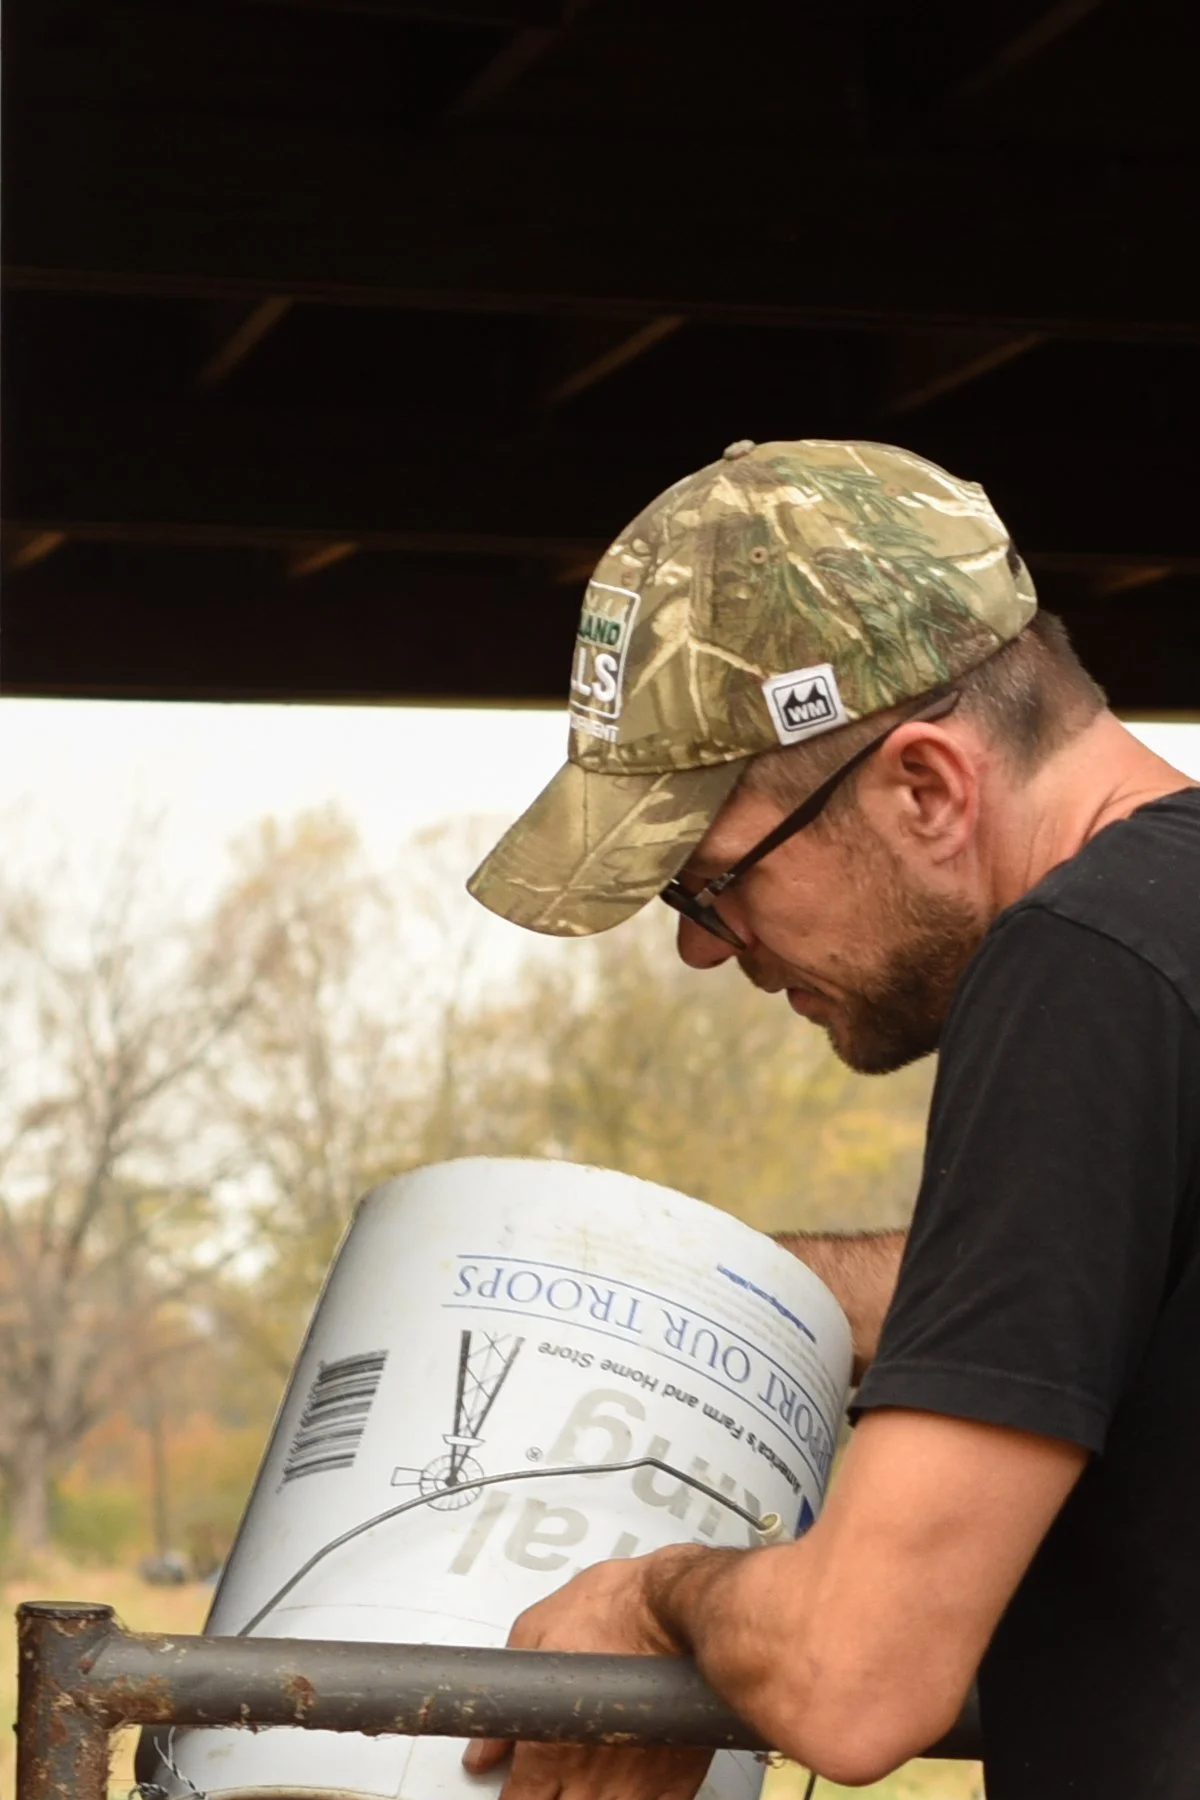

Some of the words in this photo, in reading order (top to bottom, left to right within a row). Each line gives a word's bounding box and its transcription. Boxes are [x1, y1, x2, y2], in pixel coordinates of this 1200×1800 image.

[571, 647, 617, 702] LS
[786, 698, 829, 723] WM
[453, 1264, 643, 1336] TROOPS
[537, 1341, 595, 1370] Store
[660, 1307, 752, 1385] OUR
[599, 1359, 659, 1393] Home
[662, 1382, 700, 1409] and
[701, 1401, 745, 1440] Farm
[746, 1431, 803, 1497] America's
